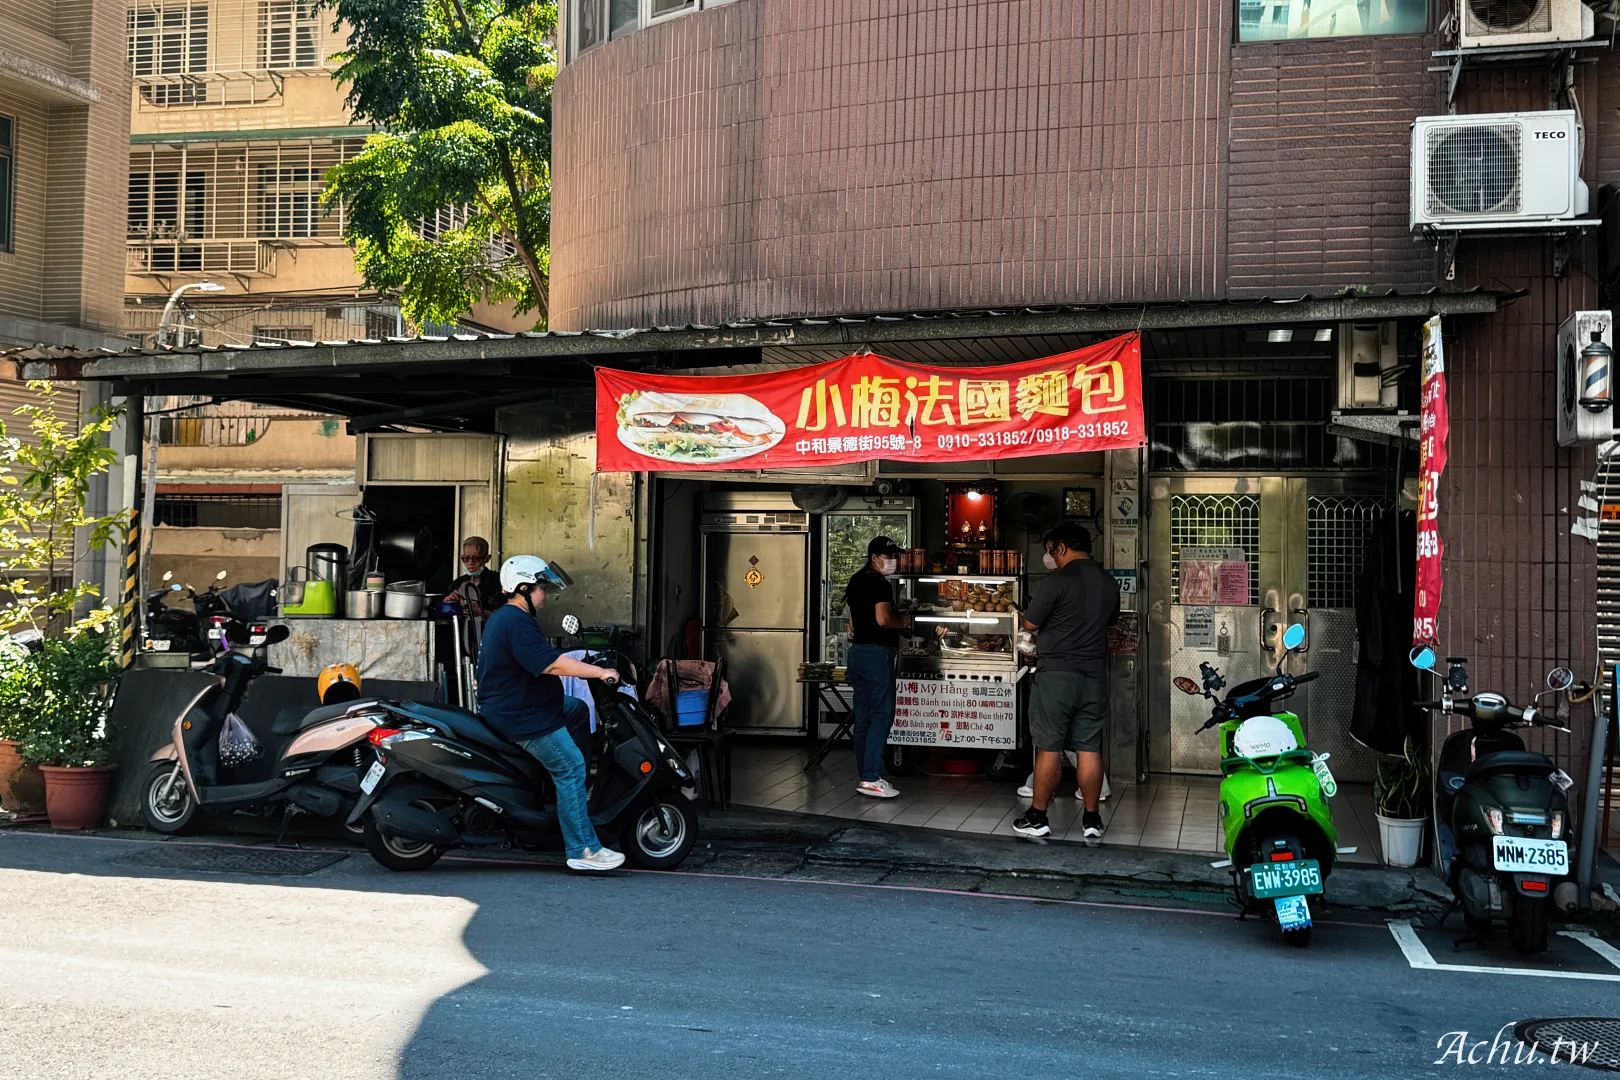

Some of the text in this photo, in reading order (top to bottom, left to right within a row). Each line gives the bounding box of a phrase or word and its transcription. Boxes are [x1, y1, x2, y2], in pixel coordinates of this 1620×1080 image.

[1534, 131, 1566, 139] TECO
[795, 360, 1127, 431] 小梅法國麵包
[795, 420, 1130, 455] 中和景德街95號-8 0910-331852/0918-331852
[896, 681, 919, 694] 小梅
[972, 686, 1013, 697] 每周三公休
[966, 699, 977, 707] 80
[984, 723, 994, 731] 40
[892, 736, 937, 744] 0910331852
